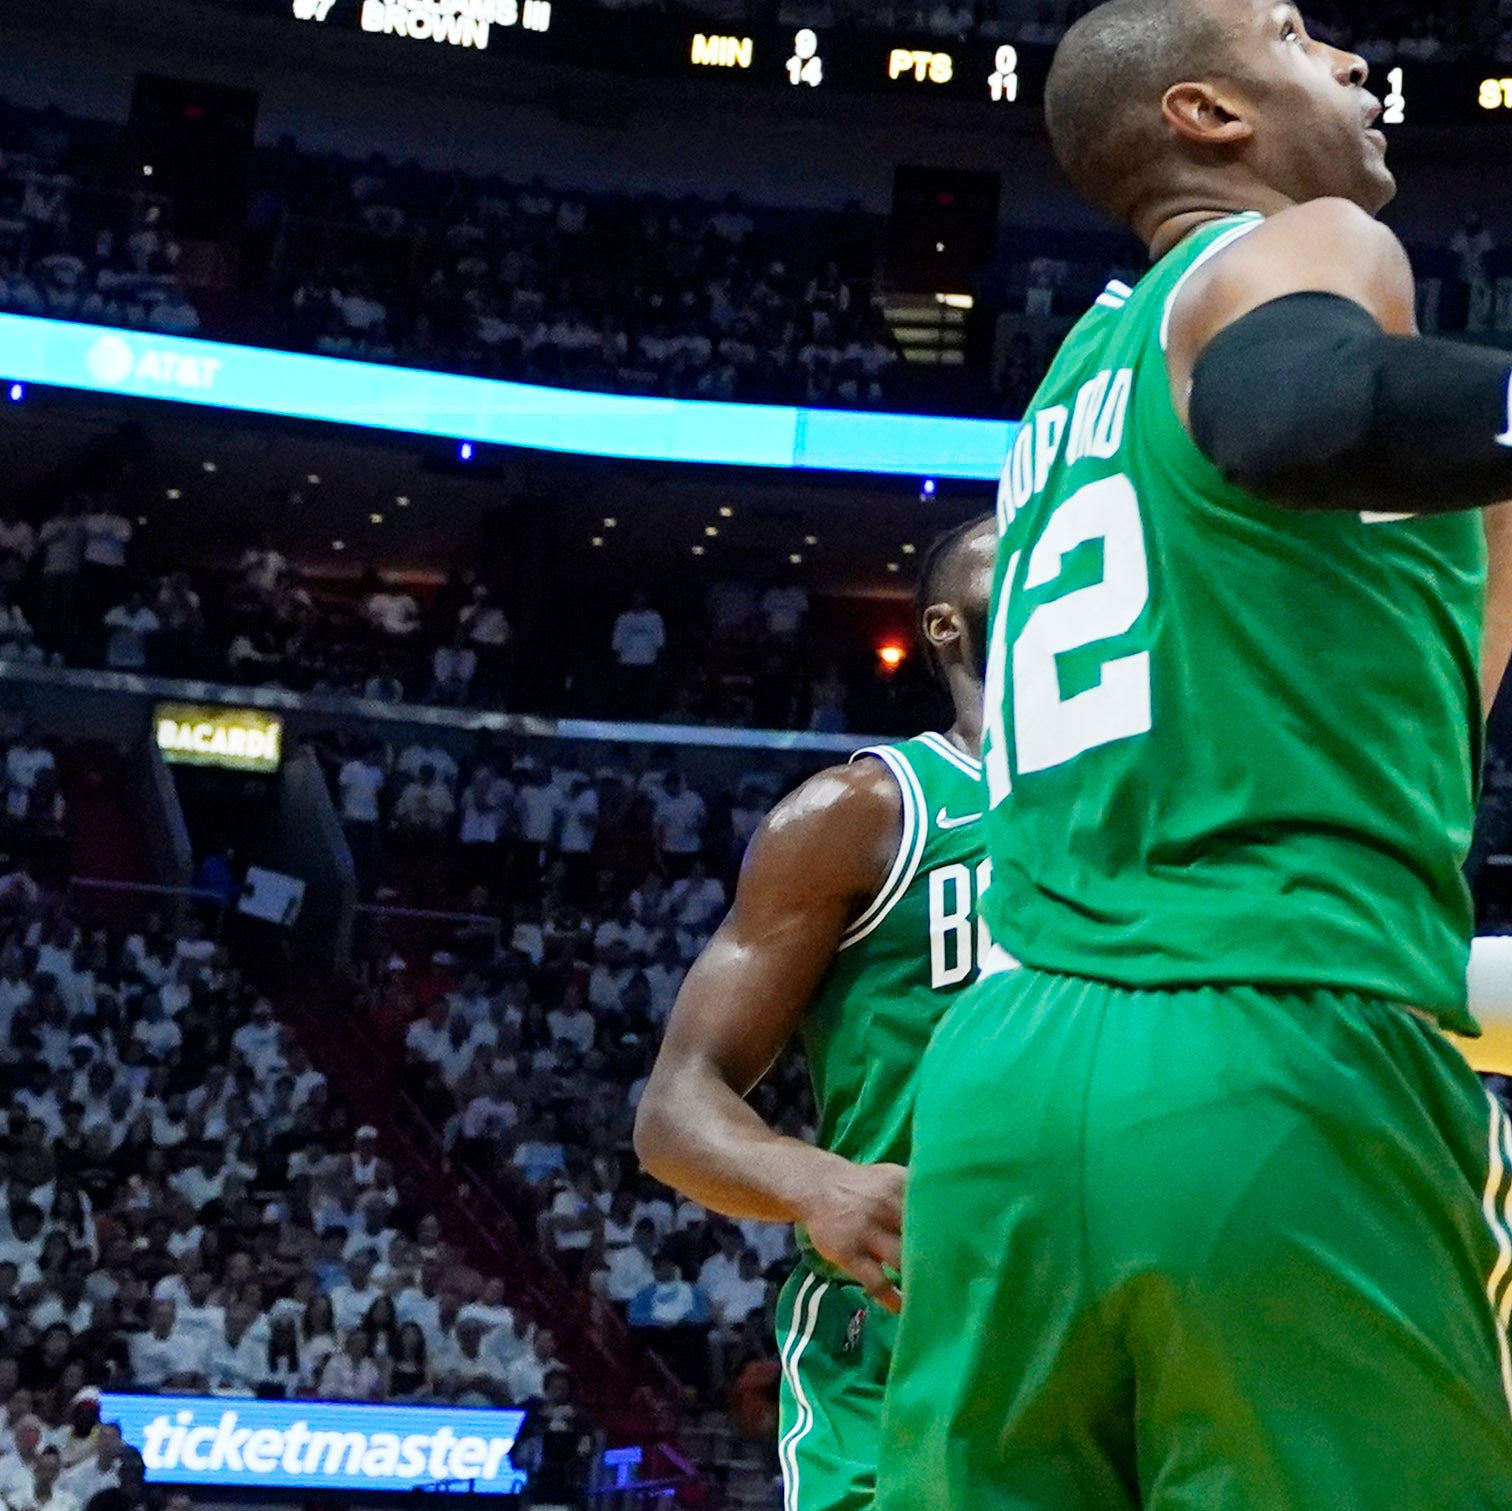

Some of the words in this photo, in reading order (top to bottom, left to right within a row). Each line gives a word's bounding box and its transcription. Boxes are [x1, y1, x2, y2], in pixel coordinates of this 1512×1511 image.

[360, 0, 491, 51] BROWN
[690, 32, 754, 70] MIN
[888, 48, 954, 85] PTS
[785, 54, 824, 88] 14
[986, 71, 1019, 103] 11
[134, 349, 224, 389] AT&T
[142, 1408, 515, 1480] ticketmaster
